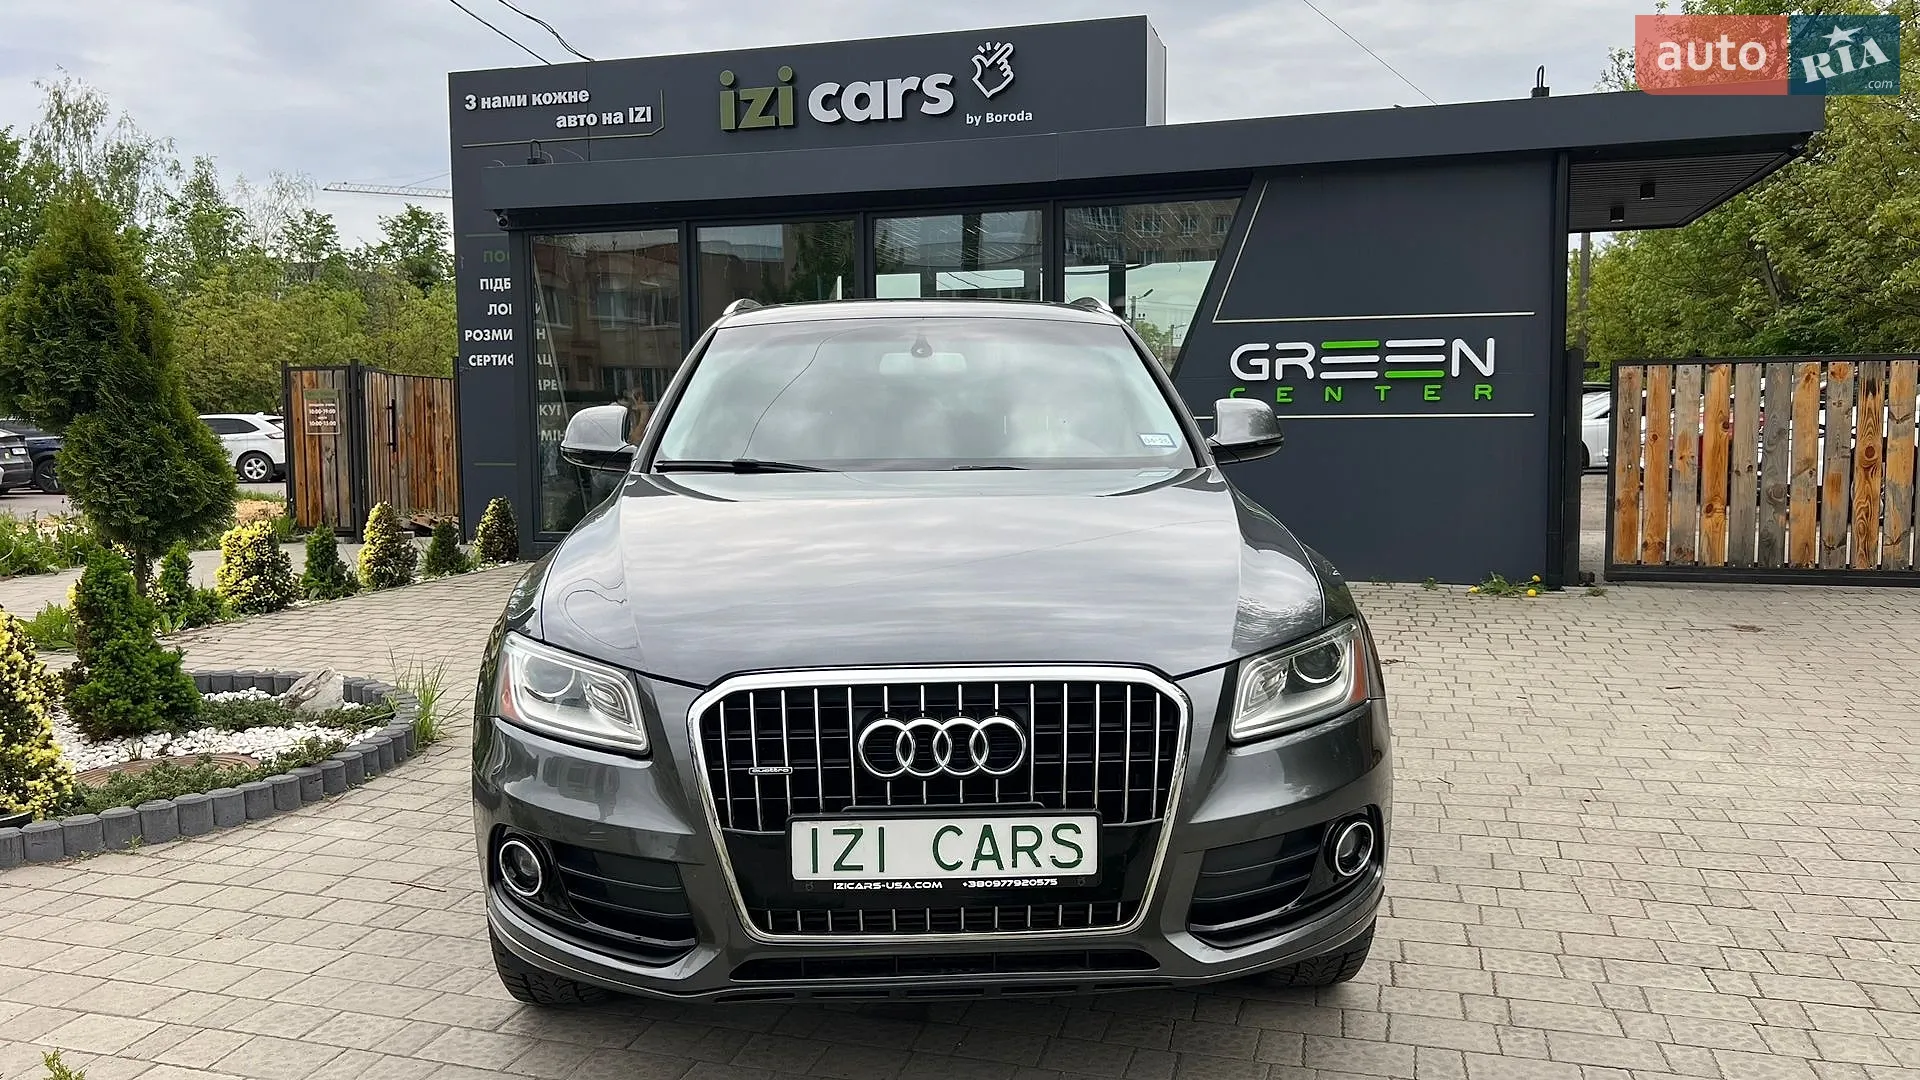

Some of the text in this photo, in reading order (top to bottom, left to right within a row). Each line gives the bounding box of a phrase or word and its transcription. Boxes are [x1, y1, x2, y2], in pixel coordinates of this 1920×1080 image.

[464, 89, 590, 110] З нами кожне
[719, 66, 954, 130] izi cars
[555, 105, 652, 129] авто на IZI
[966, 109, 1033, 127] by Boroda
[1229, 337, 1496, 381] GREEN
[1229, 383, 1494, 403] CENTER
[811, 823, 1085, 874] IZI CARS
[833, 878, 1058, 891] IZICARS-USA.COM +380977920575
